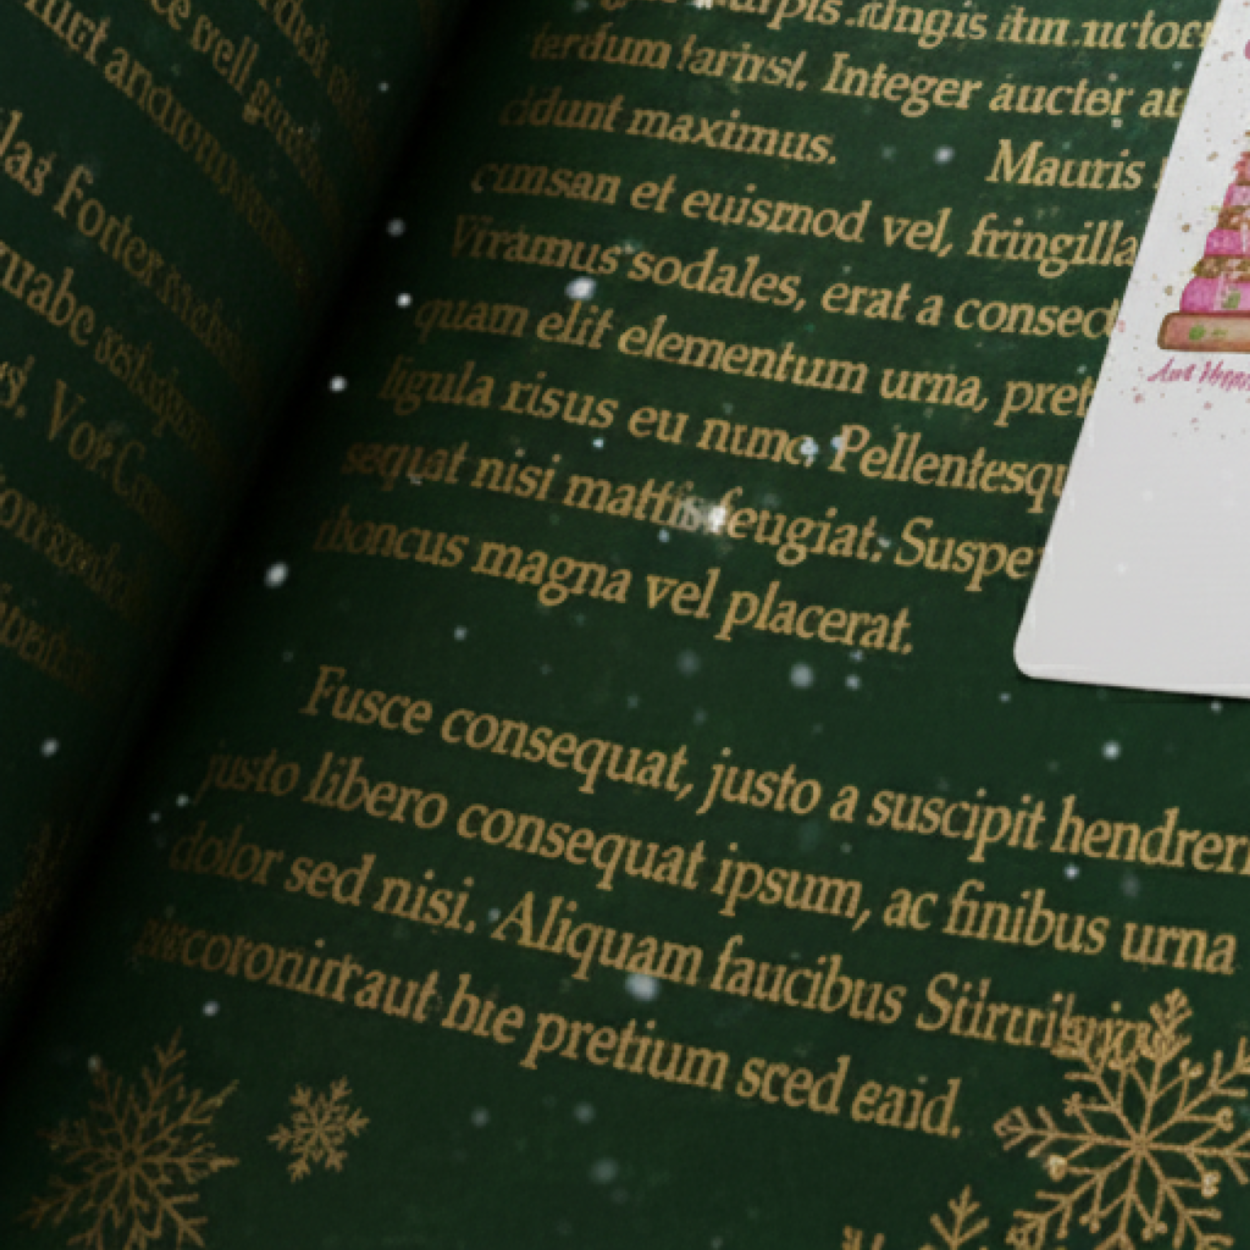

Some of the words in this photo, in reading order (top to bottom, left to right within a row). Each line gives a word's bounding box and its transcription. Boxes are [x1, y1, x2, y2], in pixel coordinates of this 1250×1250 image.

[821, 51, 983, 118] Integer
[626, 108, 837, 165] maximus.
[985, 138, 1146, 190] Mauris
[629, 173, 678, 214] et
[681, 183, 873, 244] euismod
[880, 206, 954, 259] vel,
[966, 211, 1139, 280] fringilla
[627, 243, 806, 312] sodales,
[821, 282, 912, 321] erat
[915, 294, 944, 327] a
[377, 353, 496, 417] ligula
[499, 370, 619, 429] risus
[627, 405, 690, 445] eu
[414, 295, 530, 344] quam
[535, 300, 615, 350] elit
[617, 314, 869, 395] elementum
[878, 367, 989, 414] urna,
[341, 440, 470, 493] sequat
[470, 448, 562, 502] nisi
[471, 541, 632, 607] magna
[646, 566, 722, 620] vel
[715, 580, 913, 655] placerat.
[300, 664, 433, 735] Fusce
[440, 706, 694, 802] consequat,
[696, 746, 822, 816] justo
[829, 784, 860, 824] a
[866, 786, 1048, 864] suscipit
[193, 740, 301, 806] justo
[302, 752, 449, 830] libero
[456, 802, 706, 891] consequat
[710, 842, 871, 932] ipsum,
[883, 887, 938, 931] ac
[942, 879, 1110, 956] finibus
[1120, 918, 1239, 976] urna
[168, 821, 284, 887] dolor
[284, 853, 377, 907] sed
[373, 868, 477, 933] nisi.
[491, 890, 704, 987] Aliquam
[709, 935, 908, 1025] faucibus
[518, 1011, 731, 1092] pretium
[737, 1055, 852, 1114] sced
